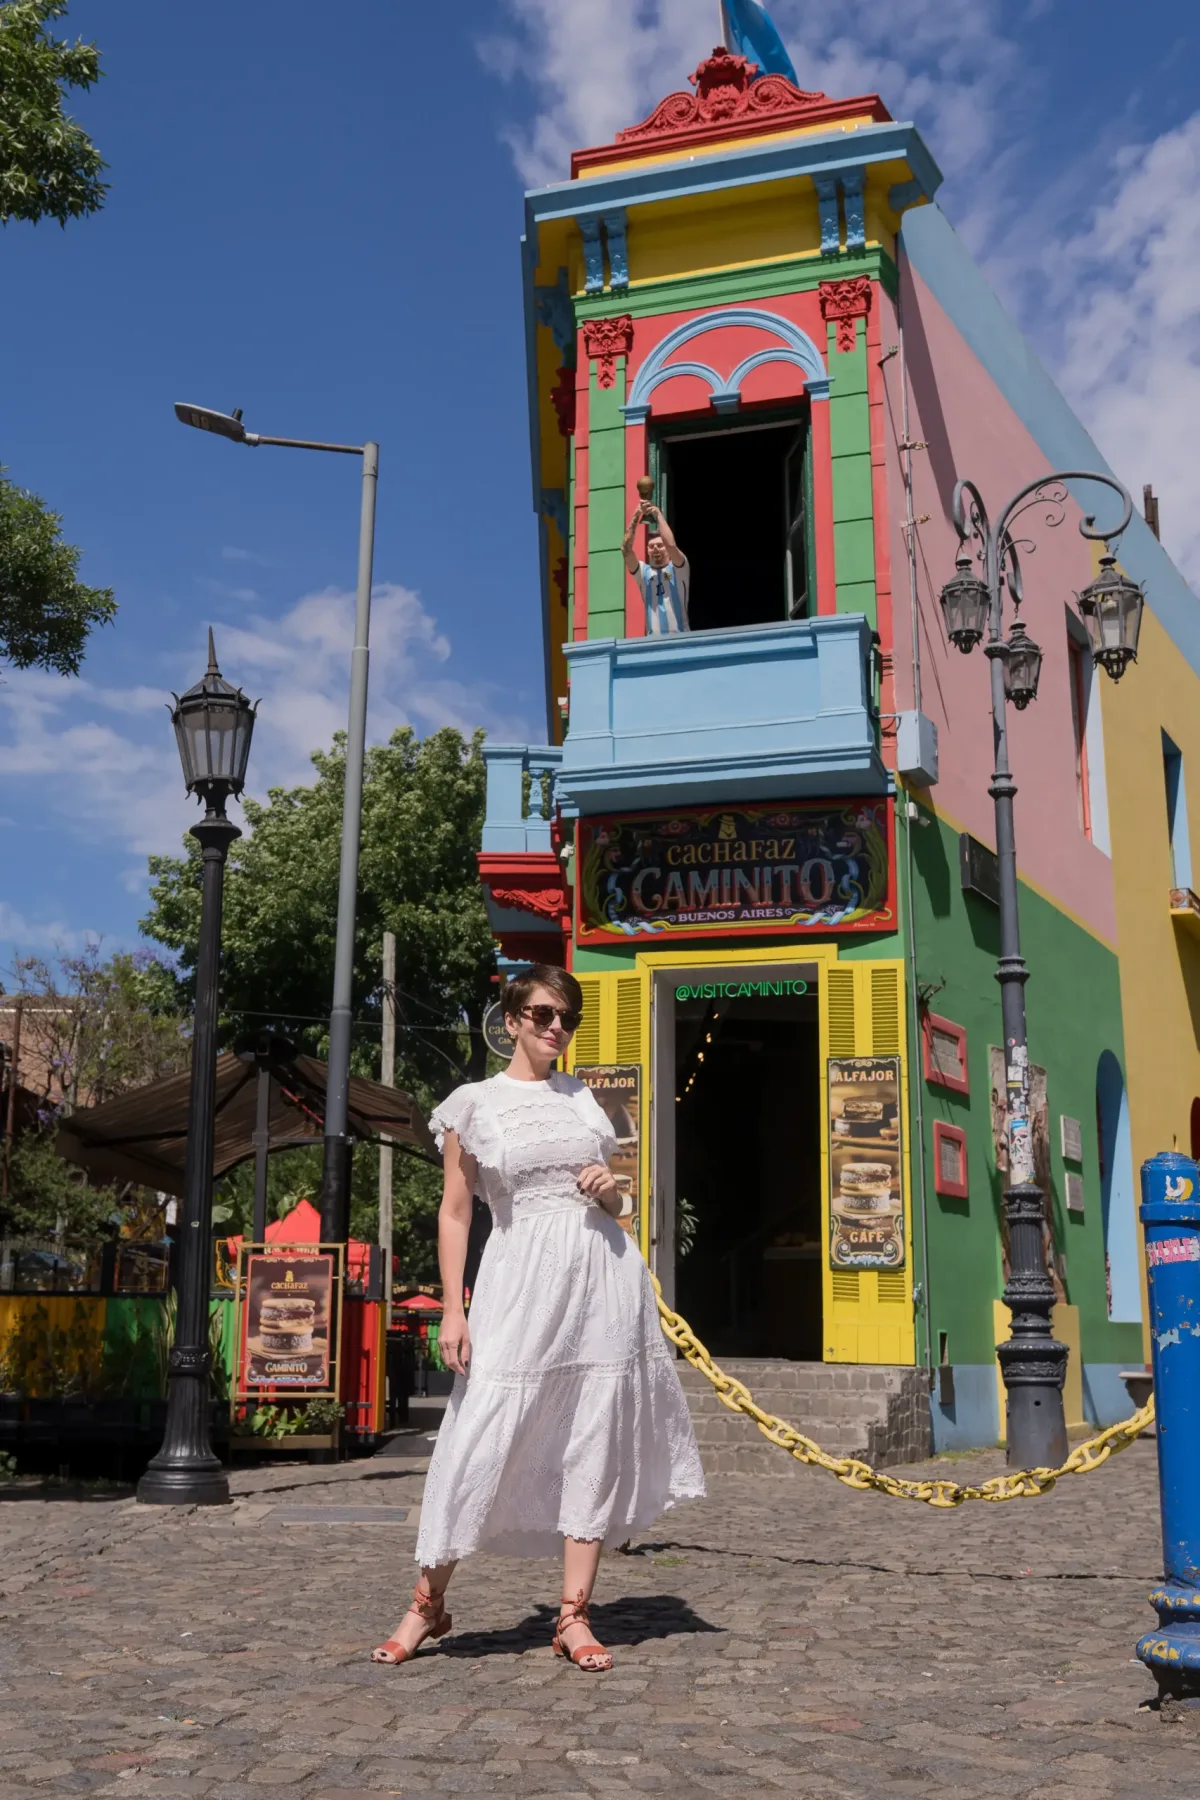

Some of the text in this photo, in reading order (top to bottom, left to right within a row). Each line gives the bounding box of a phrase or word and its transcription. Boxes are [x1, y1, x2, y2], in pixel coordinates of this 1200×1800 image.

[632, 858, 836, 914] CAMINITO
[678, 907, 784, 922] BUENOS AIRES
[675, 979, 808, 1001] @VISITCAMINITO
[836, 1069, 894, 1082] ALFAJOR
[265, 1361, 308, 1373] CAMINITO
